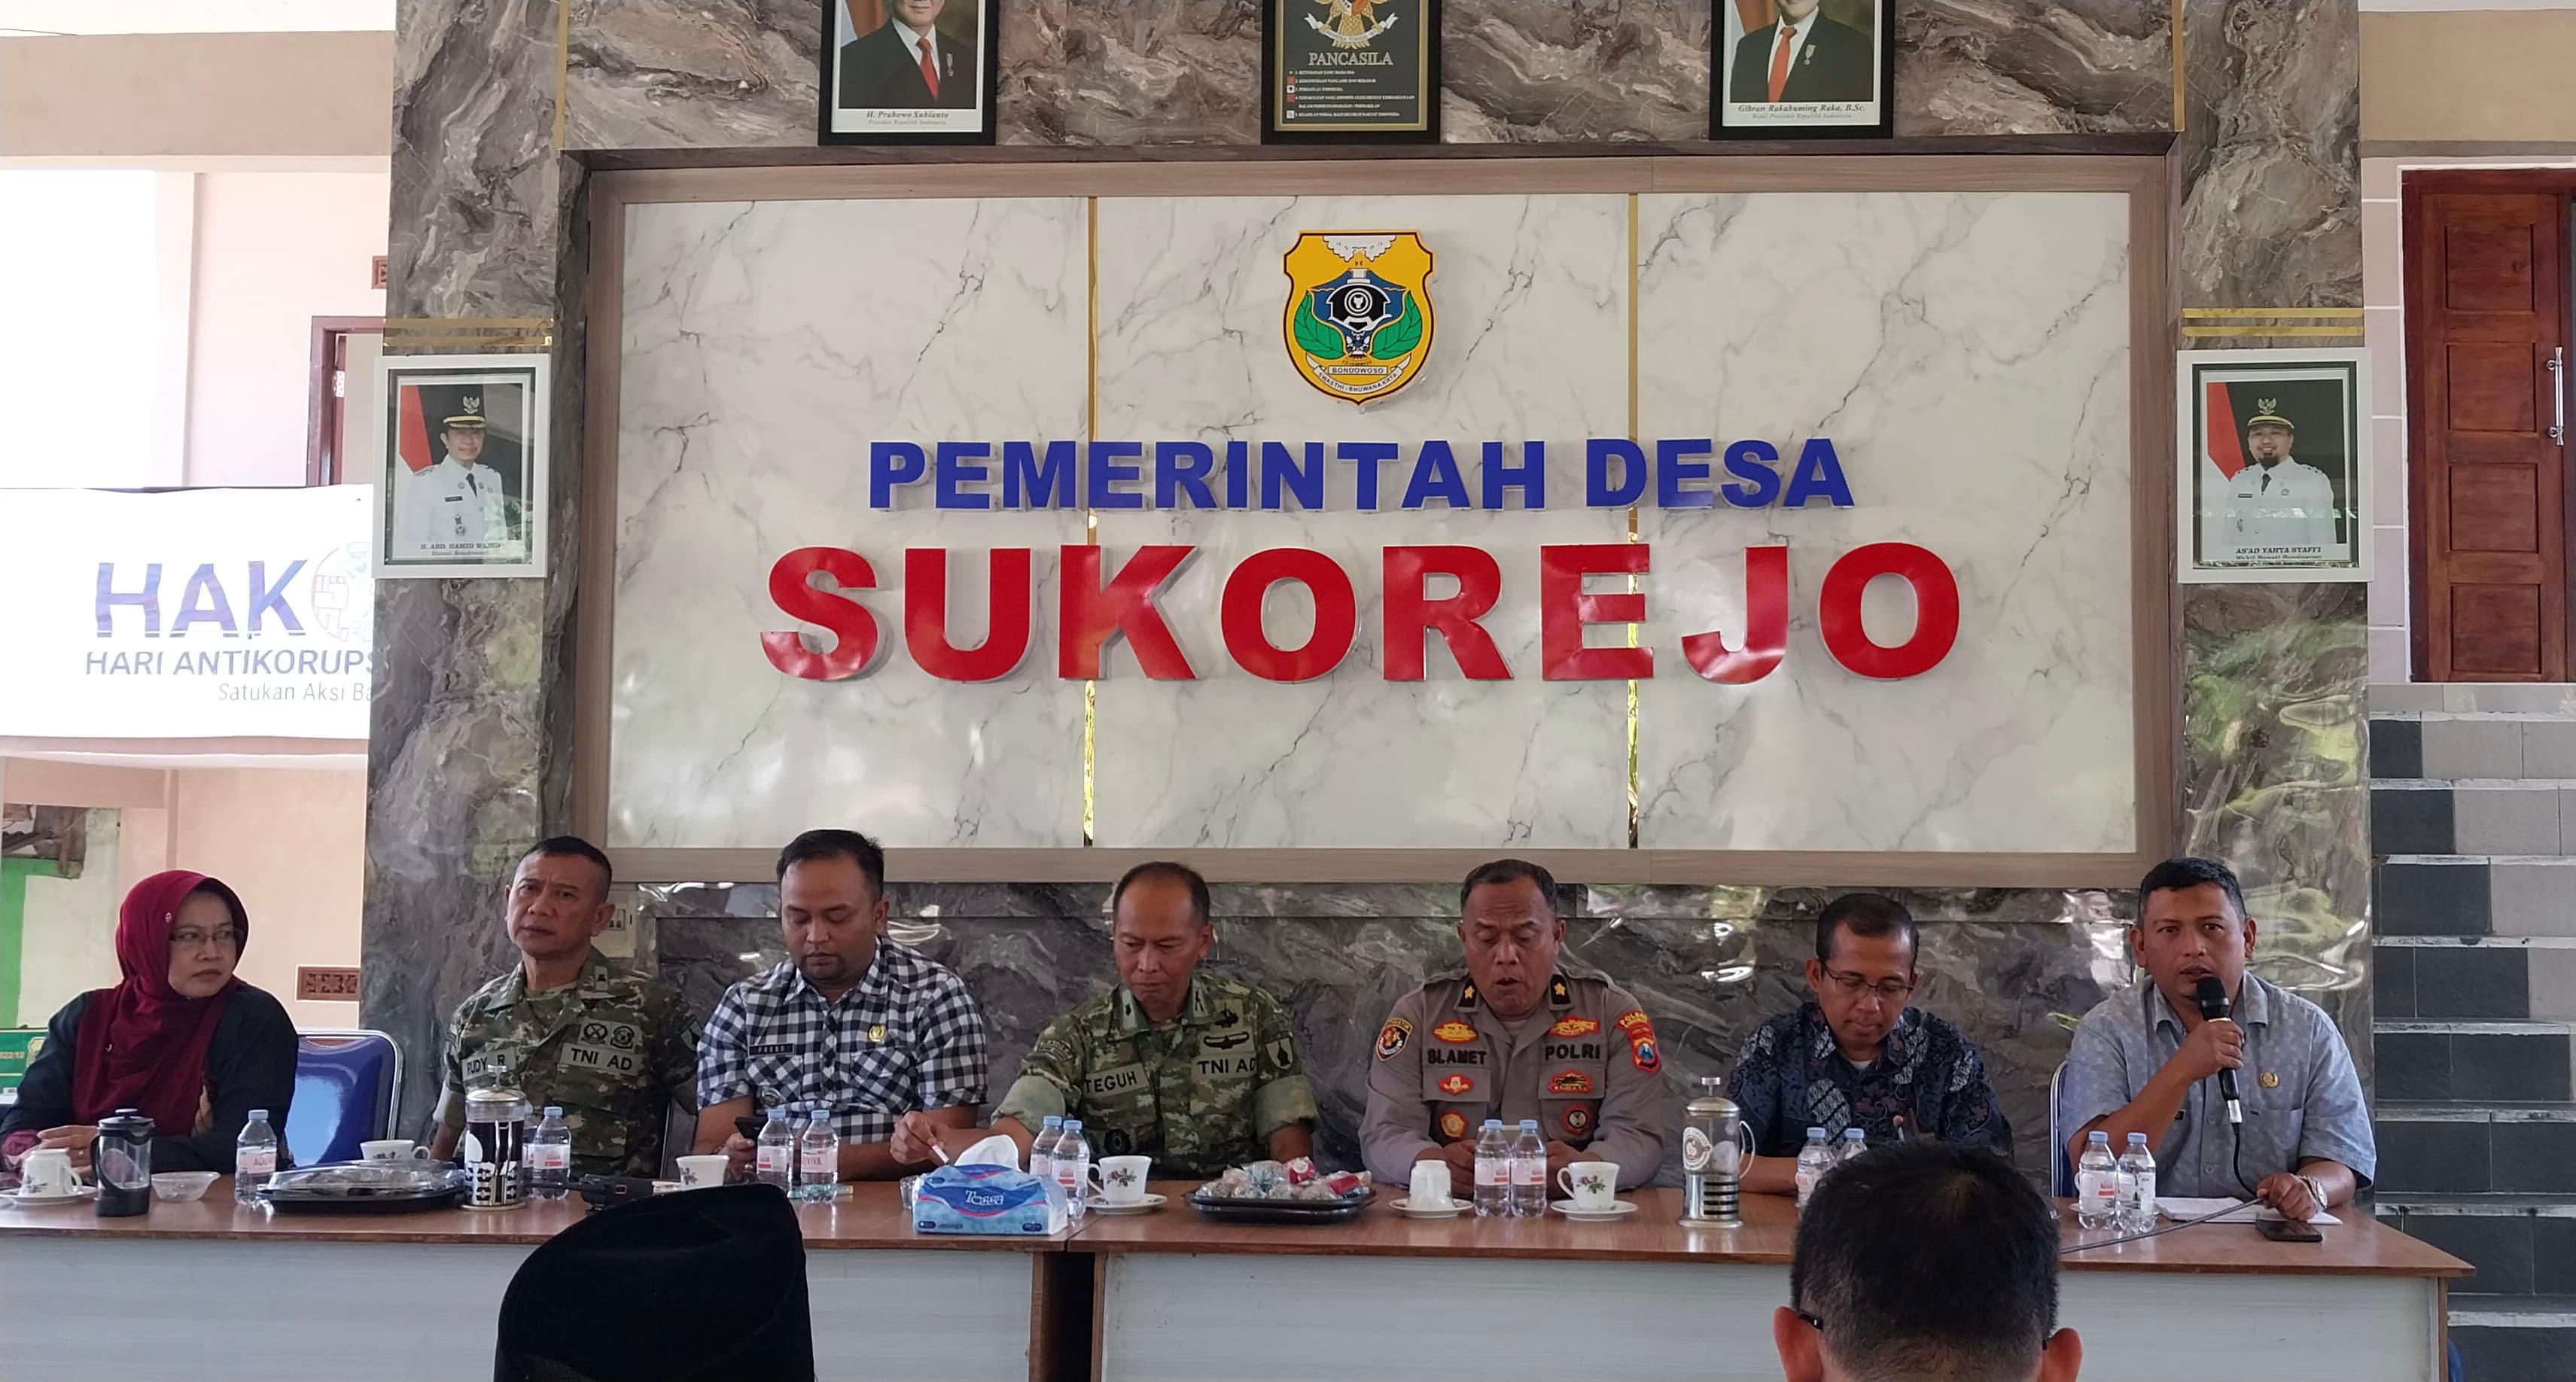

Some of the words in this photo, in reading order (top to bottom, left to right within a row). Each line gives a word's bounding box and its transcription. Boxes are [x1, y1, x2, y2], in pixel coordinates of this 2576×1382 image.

[1308, 52, 1393, 66] PANCASILA
[1738, 104, 1765, 112] Gibran
[1768, 104, 1817, 113] Rakabuming
[869, 441, 1545, 509] PEMERINTAH
[1586, 439, 1854, 507] DESA
[762, 542, 1962, 683] SUKOREJO
[86, 651, 164, 675] HARI
[218, 683, 295, 702] Satukan
[303, 682, 345, 702] Aksi
[497, 1054, 505, 1066] R
[571, 1048, 599, 1064] TNI
[607, 1055, 632, 1070] AD
[1427, 1048, 1487, 1065] SLAMET
[1545, 1043, 1600, 1061] POLRI
[1197, 1058, 1229, 1074] TNI
[1083, 1070, 1137, 1094] TEGUH
